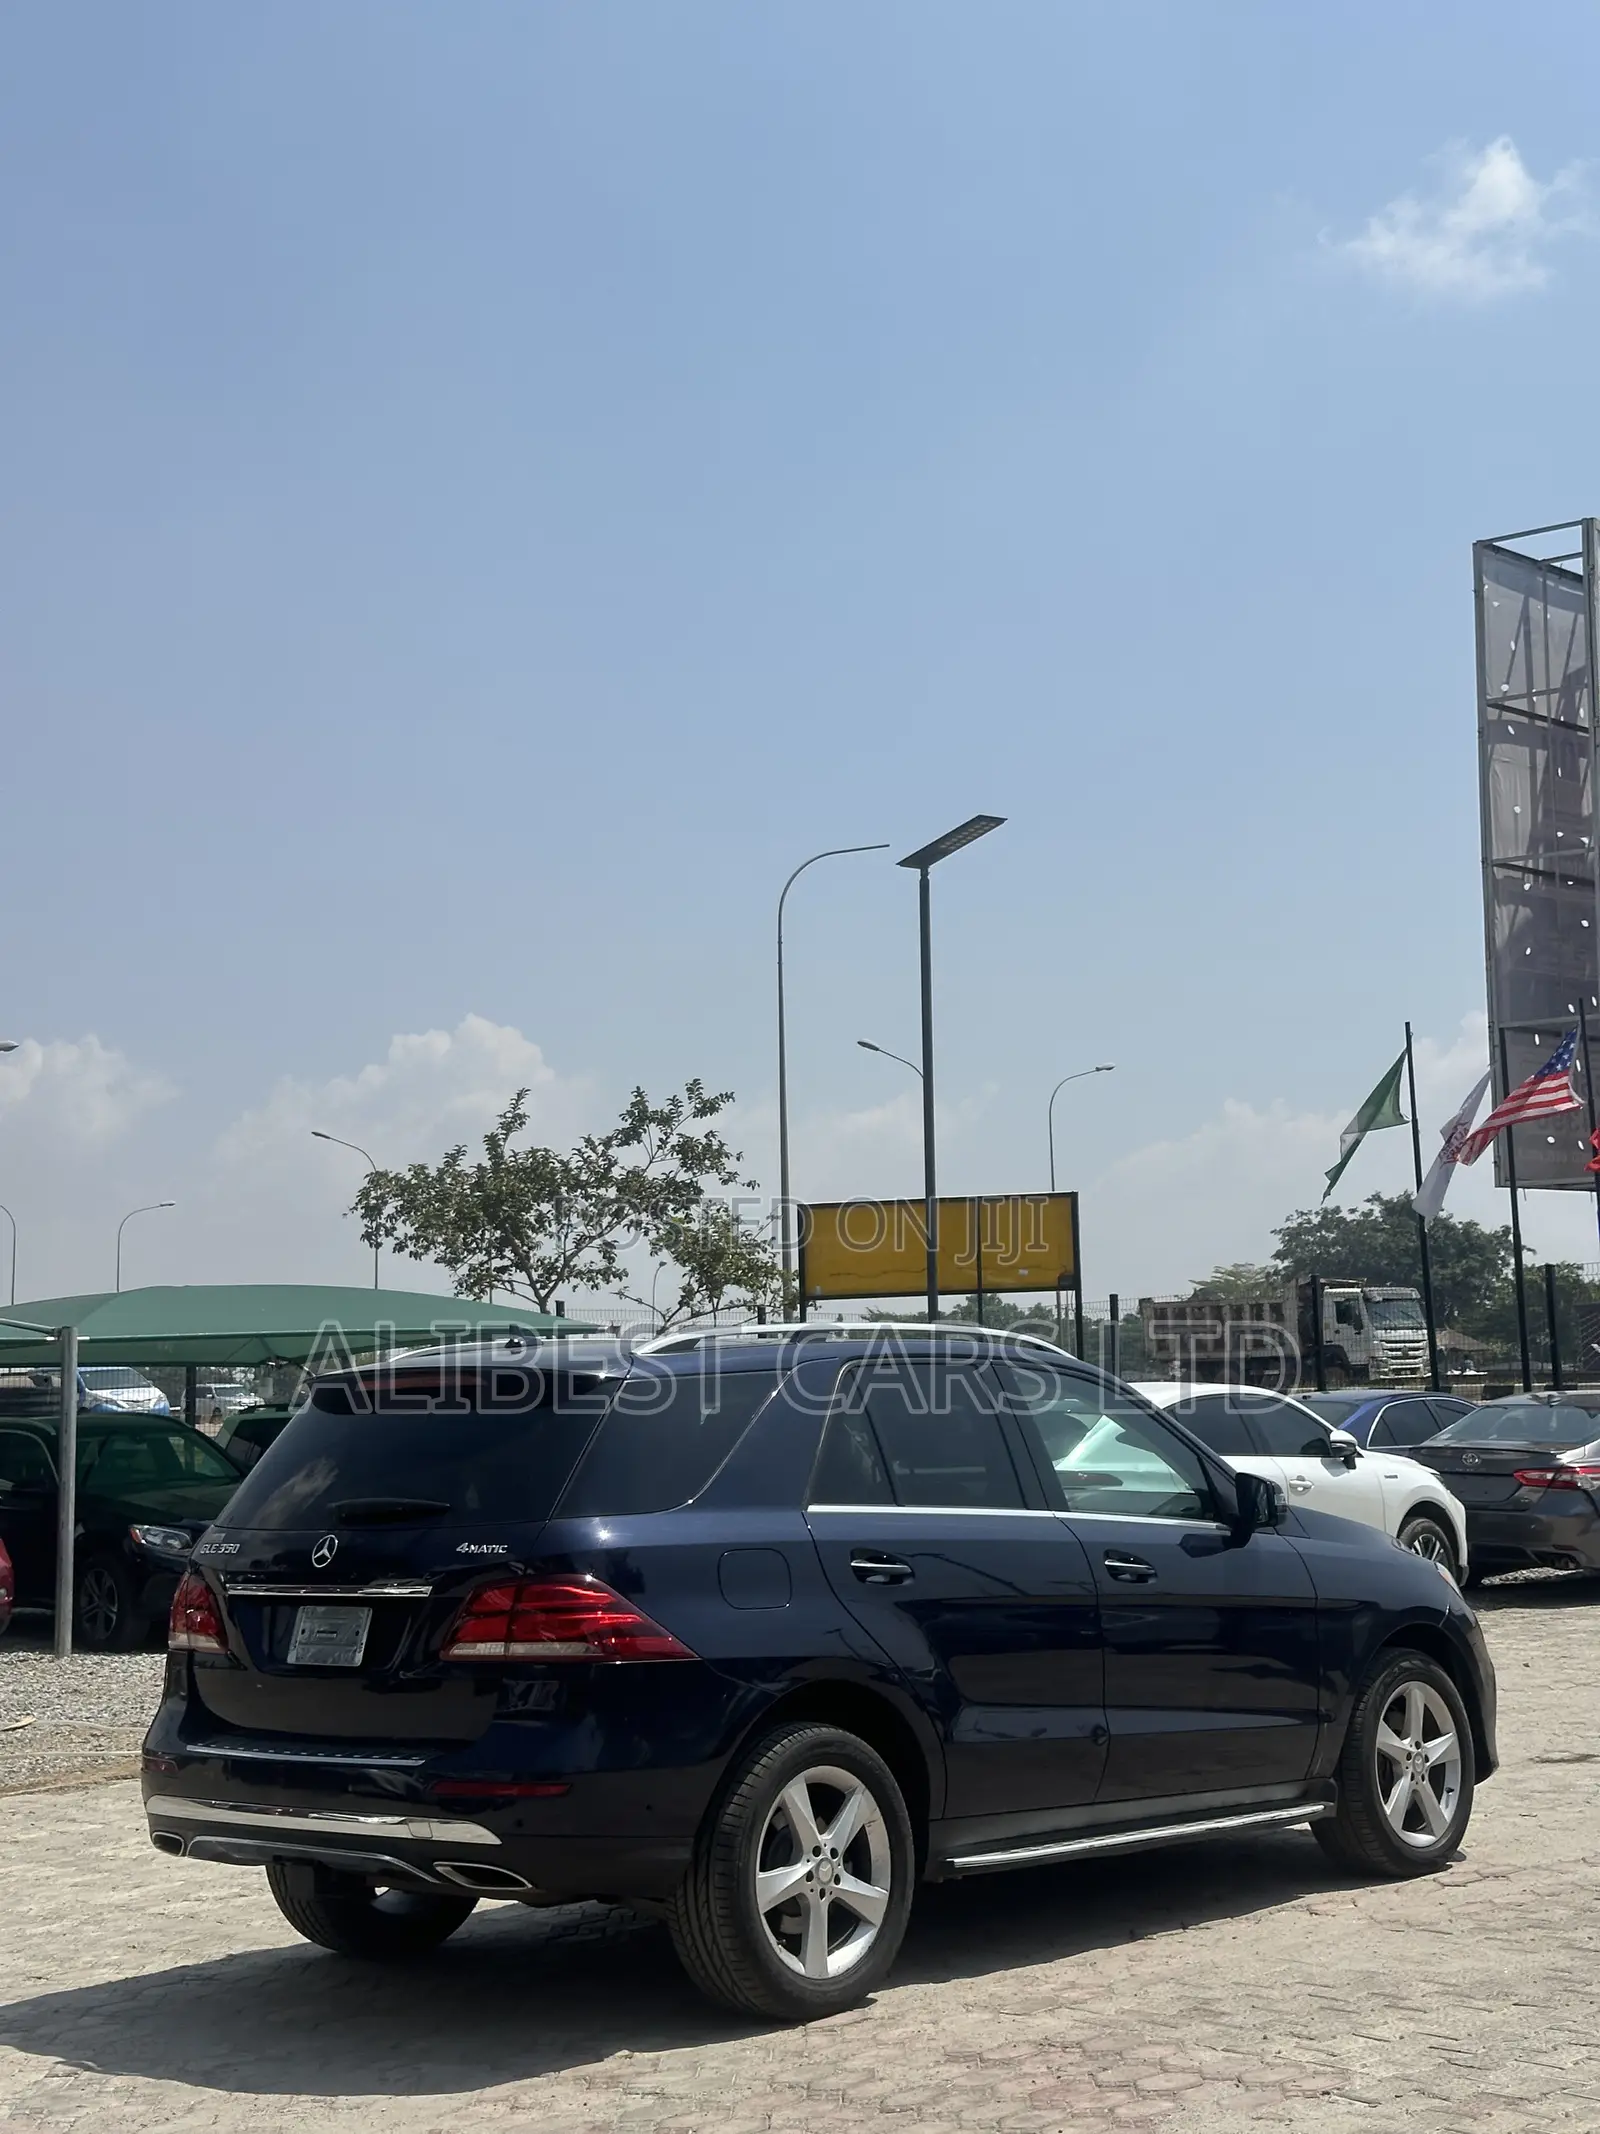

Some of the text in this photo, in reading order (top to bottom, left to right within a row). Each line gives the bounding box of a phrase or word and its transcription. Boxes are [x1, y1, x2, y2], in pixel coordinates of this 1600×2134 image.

[200, 1543, 241, 1554] GLE 350
[455, 1542, 508, 1554] 4MATIC
